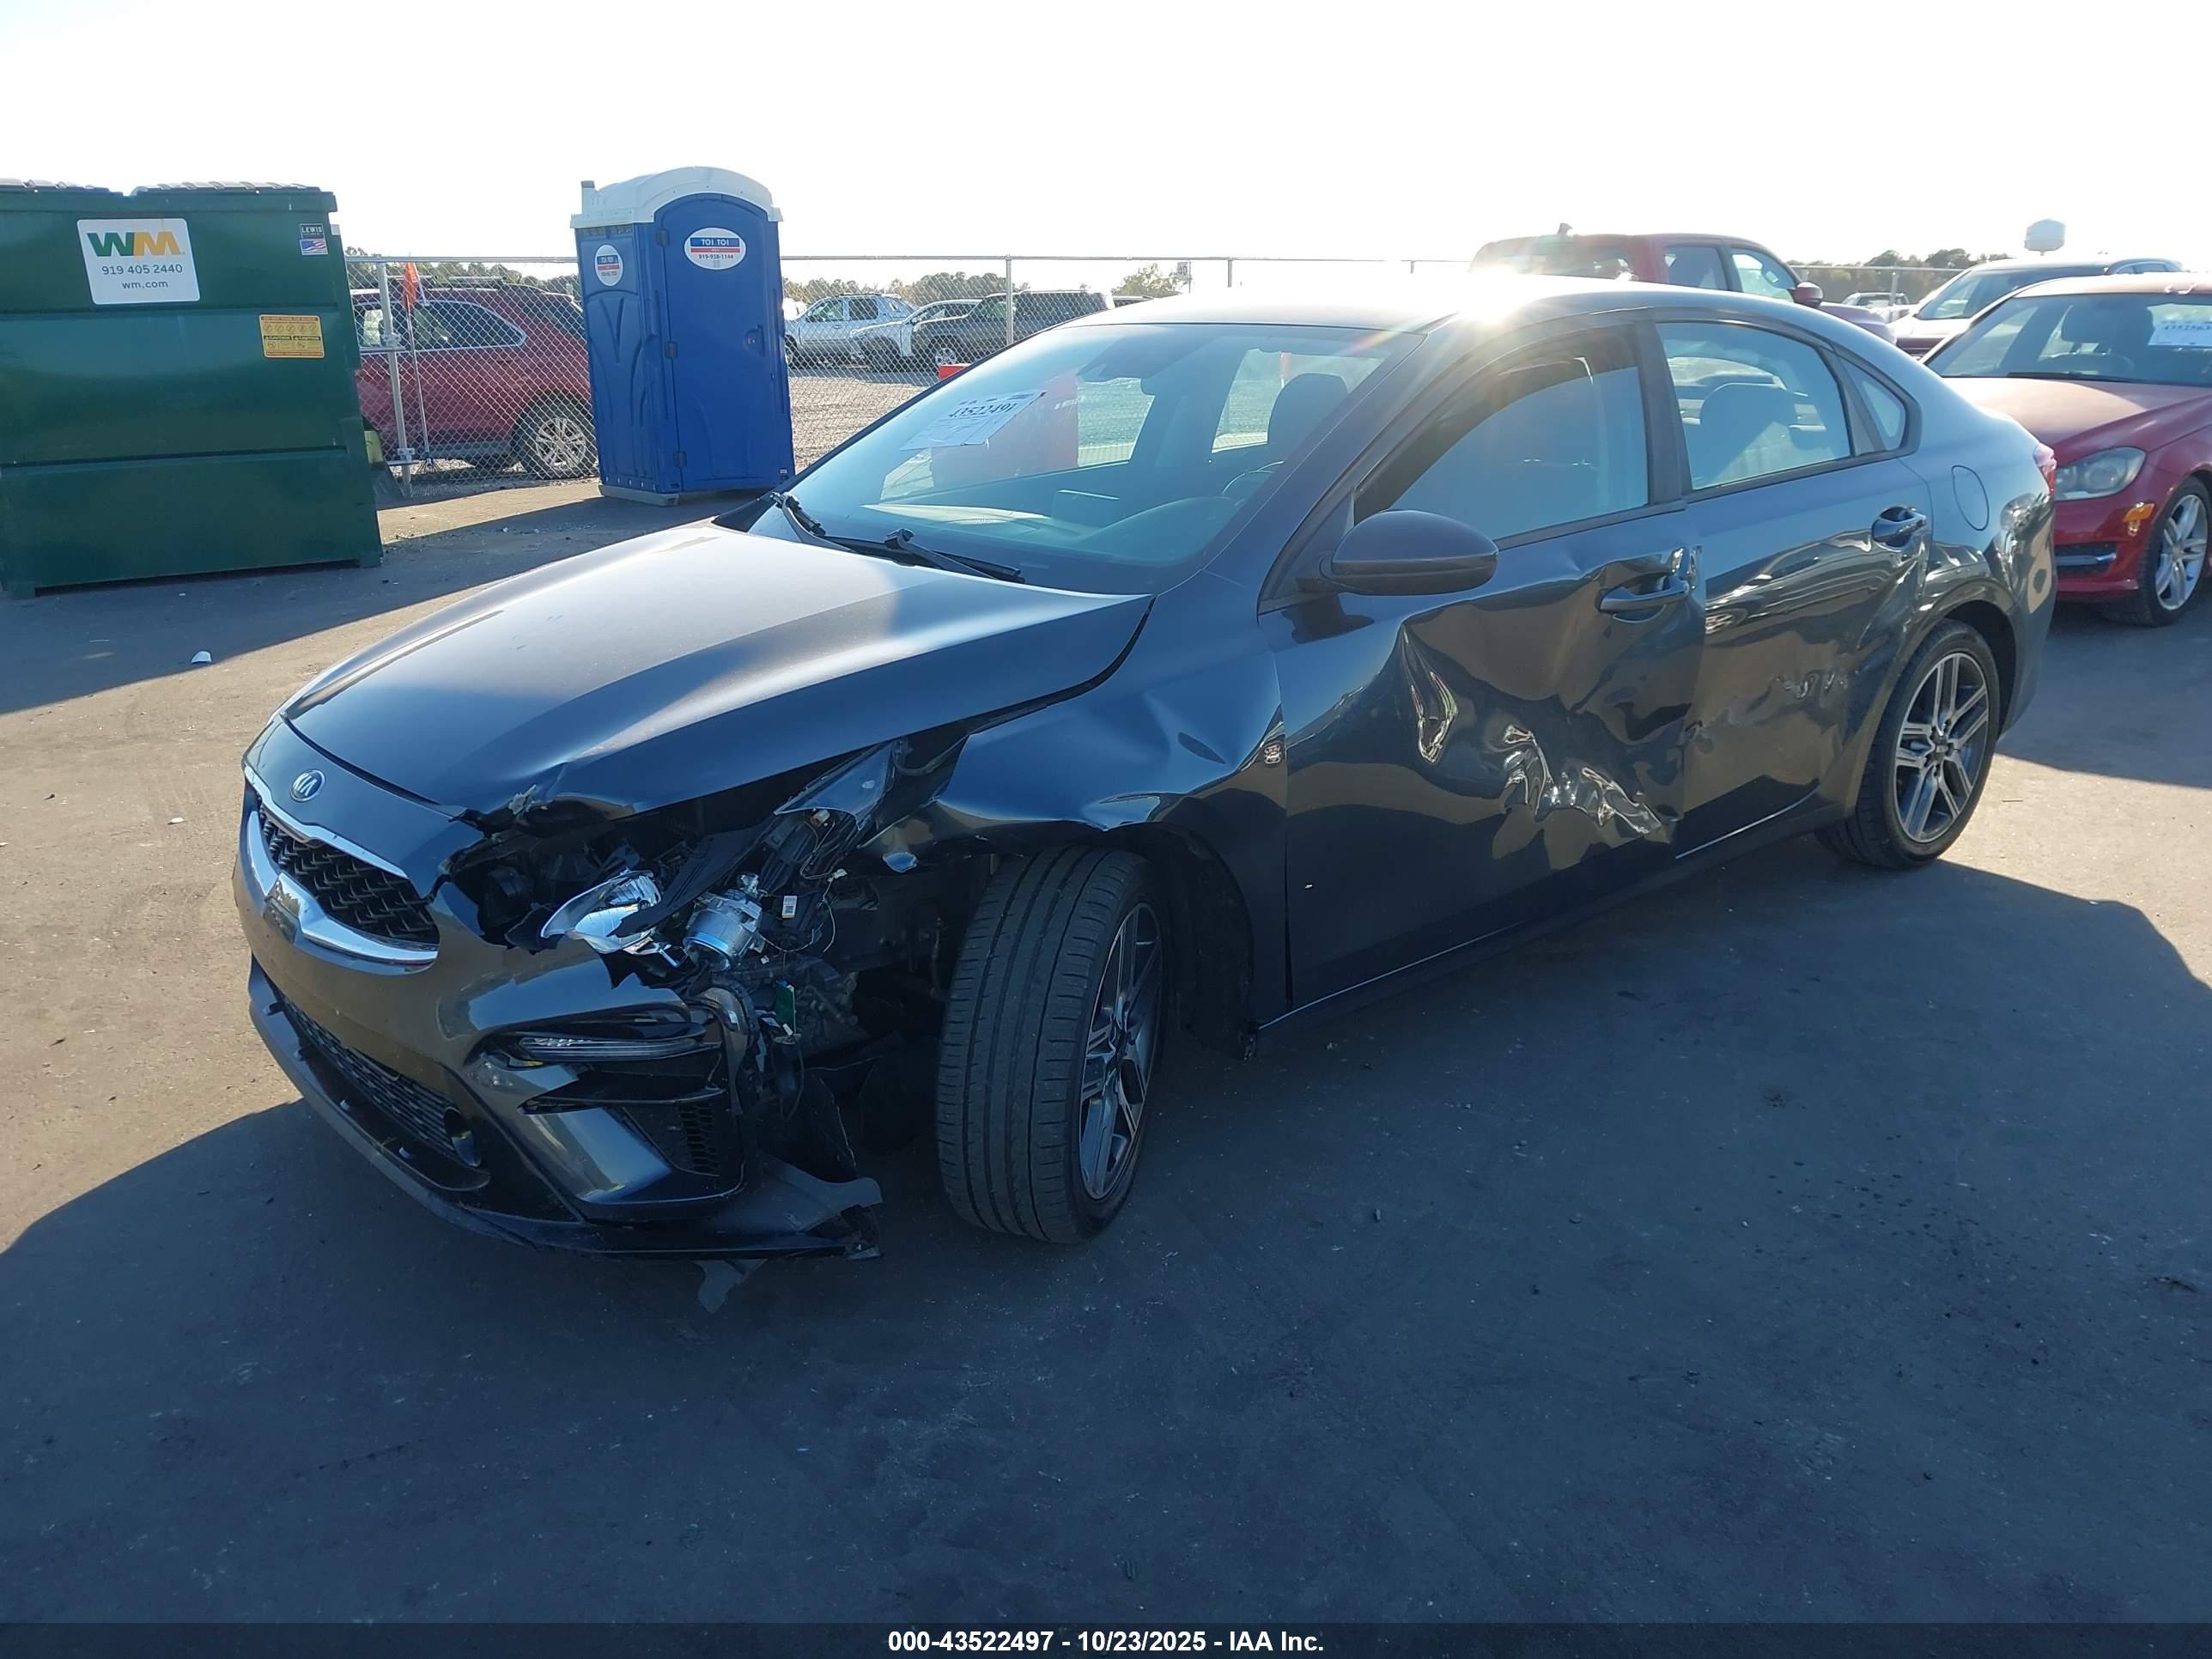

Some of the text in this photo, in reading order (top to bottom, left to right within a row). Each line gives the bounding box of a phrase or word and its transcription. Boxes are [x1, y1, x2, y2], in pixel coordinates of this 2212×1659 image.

[87, 232, 182, 257] WM
[102, 264, 183, 276] 919 405 2440
[122, 280, 169, 289] wm.com
